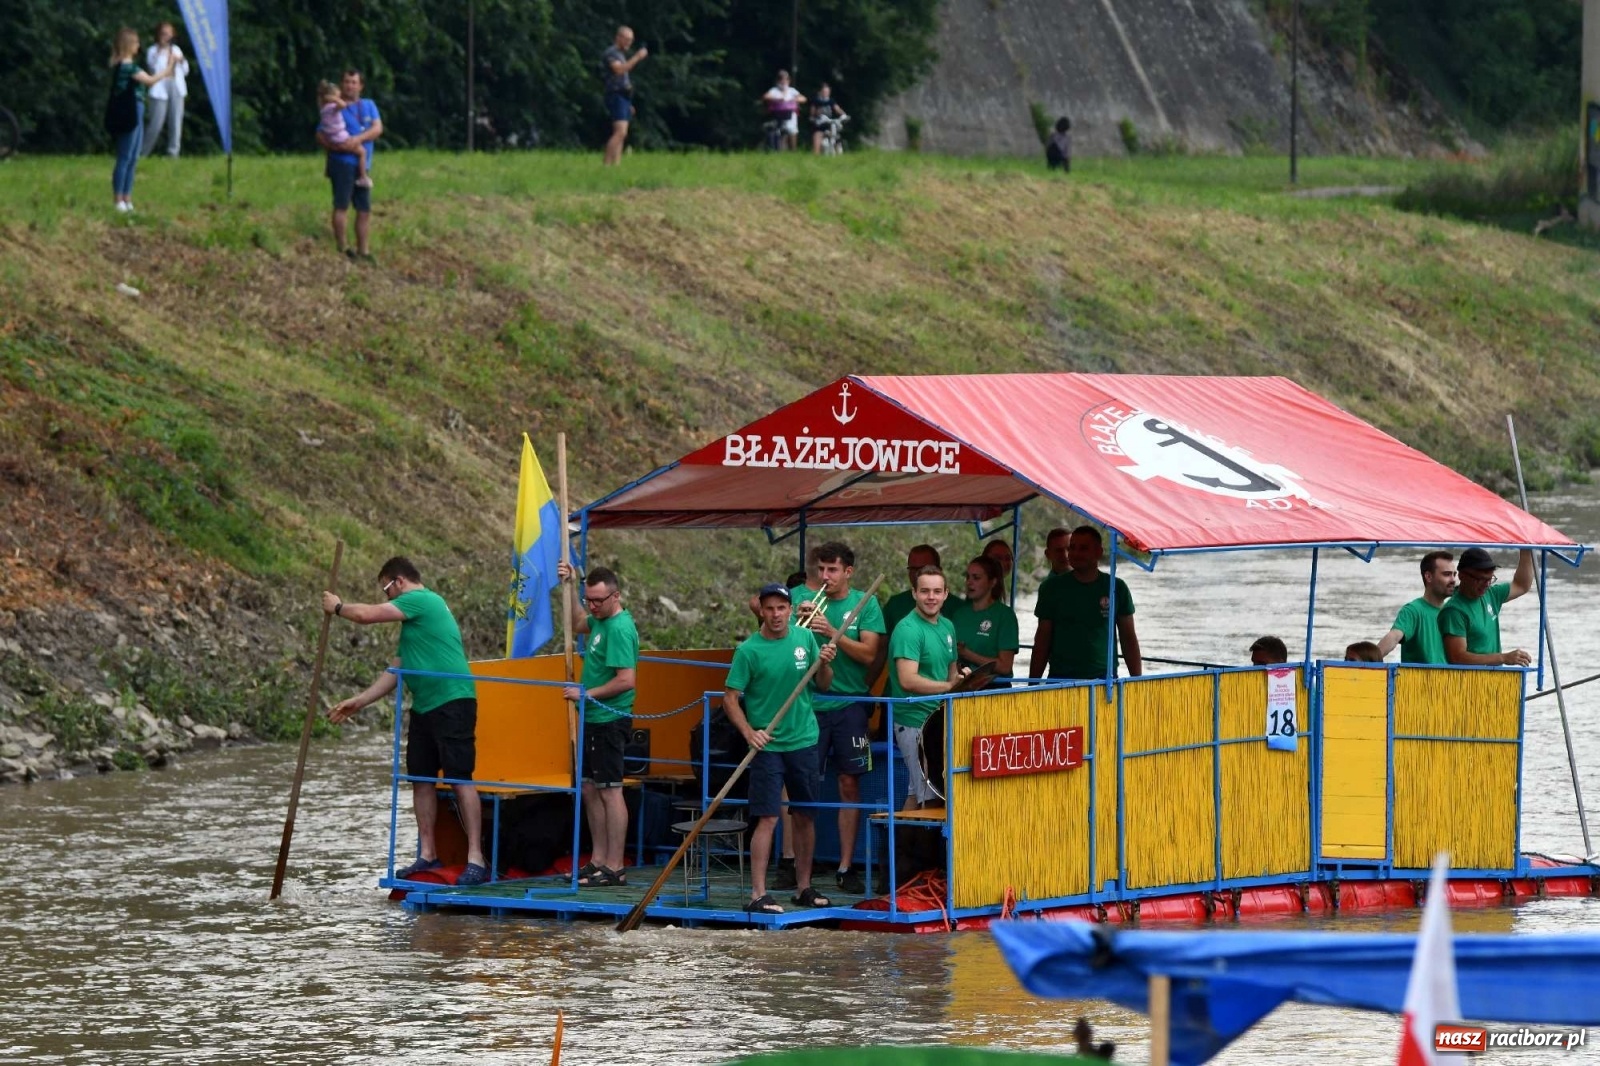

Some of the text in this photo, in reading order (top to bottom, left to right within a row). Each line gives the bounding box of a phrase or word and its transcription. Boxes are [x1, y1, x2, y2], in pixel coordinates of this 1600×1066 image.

[722, 427, 960, 474] BŁAŻEJOWICE
[1269, 709, 1295, 737] 18
[980, 731, 1077, 771] BŁAŻEJOWICE
